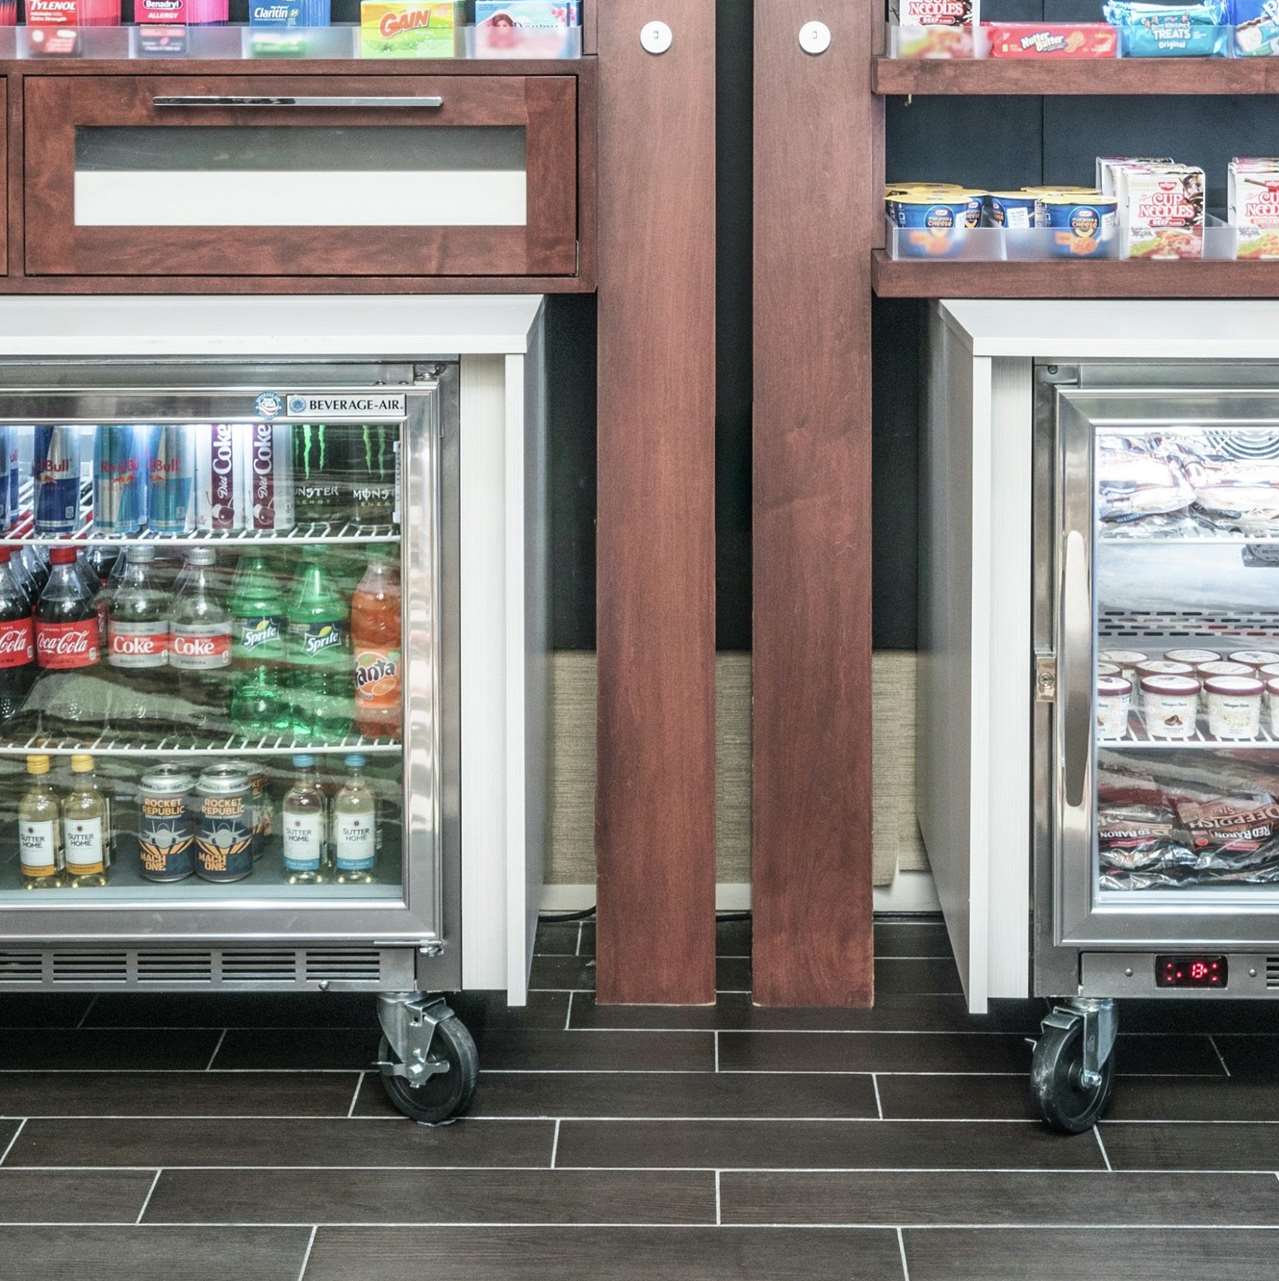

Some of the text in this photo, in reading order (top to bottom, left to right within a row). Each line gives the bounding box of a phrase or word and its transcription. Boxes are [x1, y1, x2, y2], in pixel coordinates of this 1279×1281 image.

[30, 0, 76, 11] TYLENOL
[145, 0, 180, 11] Benadryl
[254, 5, 288, 19] Claritin
[908, 2, 965, 17] NOODLES
[1152, 193, 1184, 206] CUP
[1139, 204, 1194, 219] NOODLES
[308, 398, 403, 412] BEVERAGE-AIR
[213, 423, 231, 476] Coke
[254, 423, 272, 476] Coke
[243, 625, 277, 649] Sprite
[306, 632, 339, 653] Sprite
[114, 636, 155, 654] Coke
[174, 637, 215, 656] Coke
[144, 798, 182, 808] ROCKET
[205, 797, 243, 808] ROCKET
[142, 805, 185, 817] REPUBLIC
[202, 804, 245, 816] REPUBLIC
